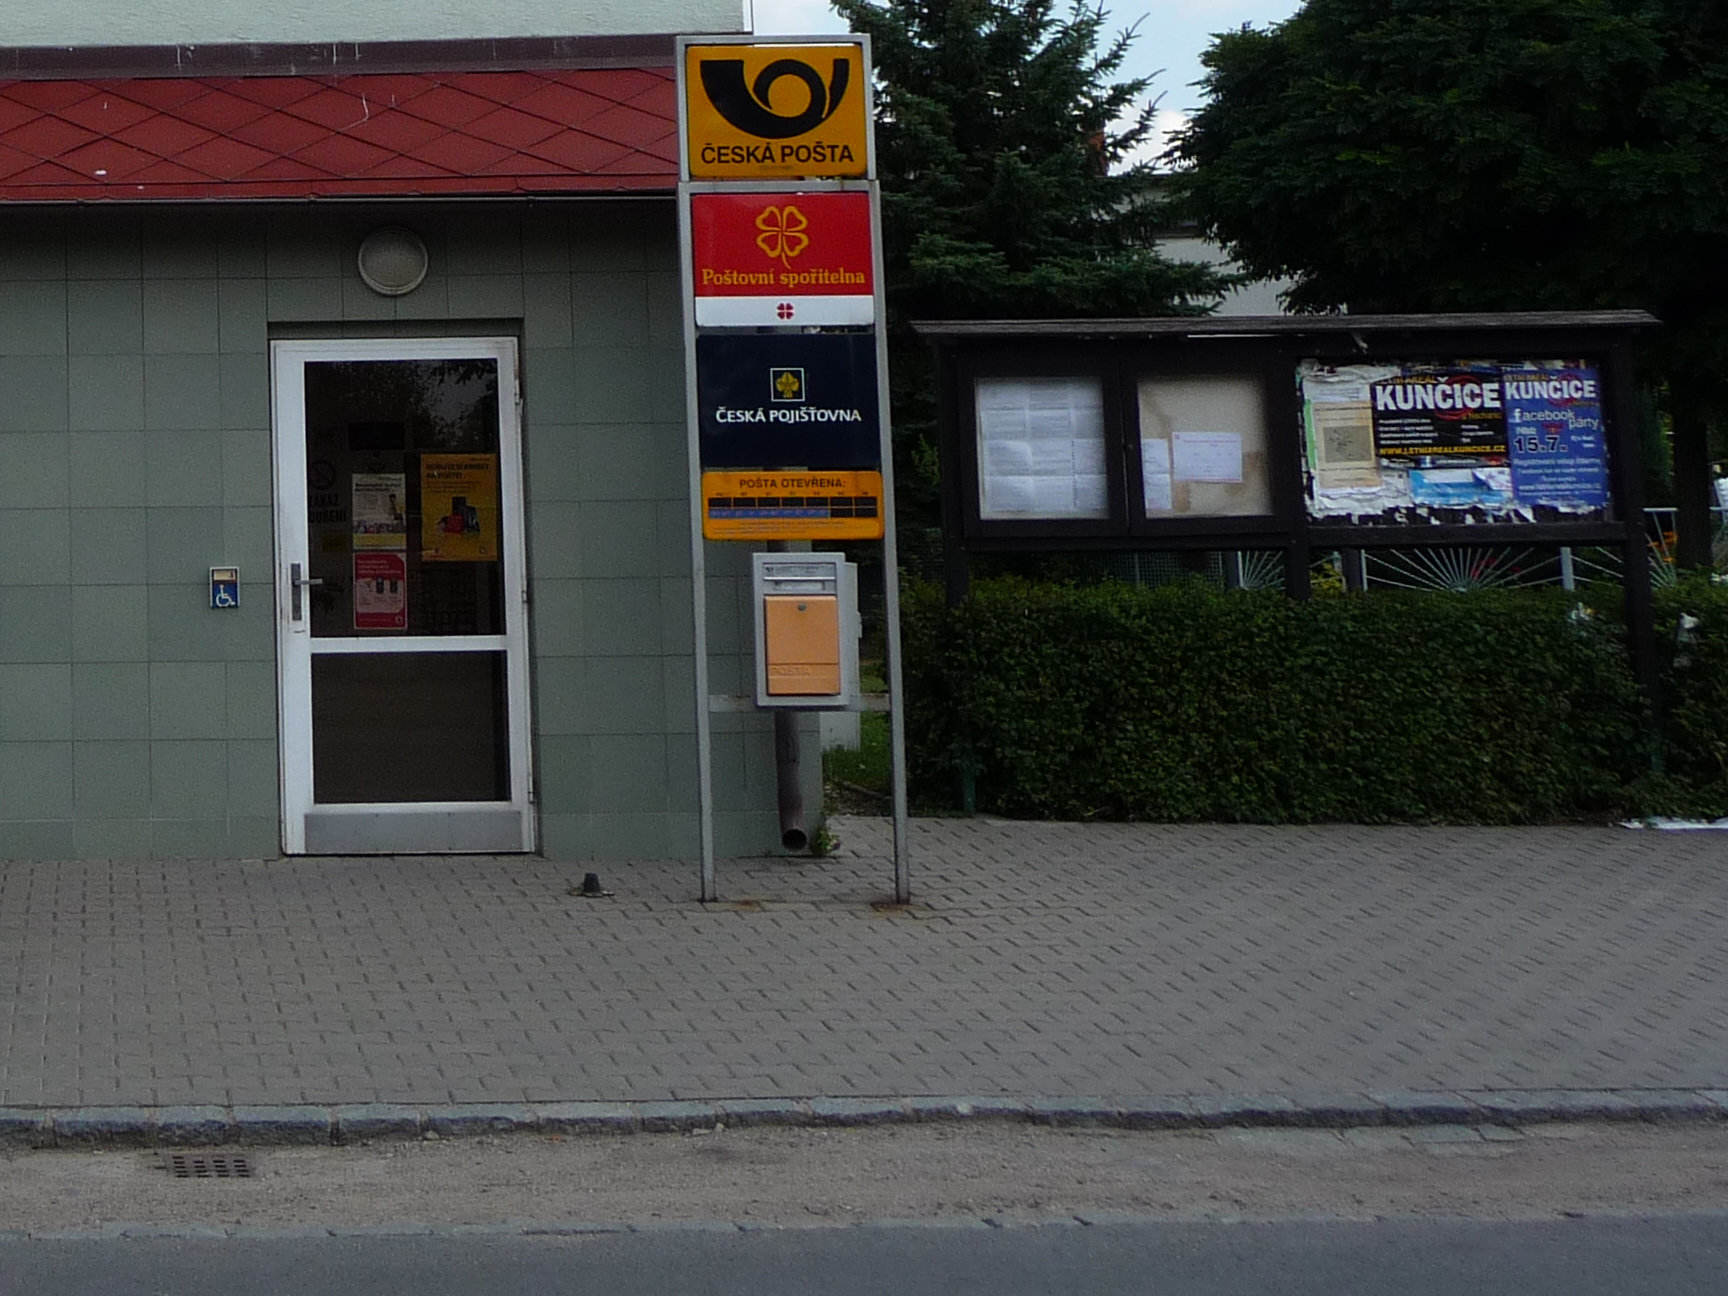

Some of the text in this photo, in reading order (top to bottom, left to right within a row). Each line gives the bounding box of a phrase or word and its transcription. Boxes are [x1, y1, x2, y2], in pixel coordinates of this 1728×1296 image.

[700, 141, 854, 164] ČESKÁ POŠTA
[702, 266, 866, 288] Poštovní spořitelna
[1375, 376, 1503, 411] KUNČICE
[1505, 375, 1597, 400] KUNČICE
[715, 406, 862, 424] ČESKÁ POJIŠŤOVNA
[1514, 408, 1575, 423] facebook
[1513, 435, 1568, 454] 15.7.
[739, 476, 847, 489] POŠTA OTEVŘENA:
